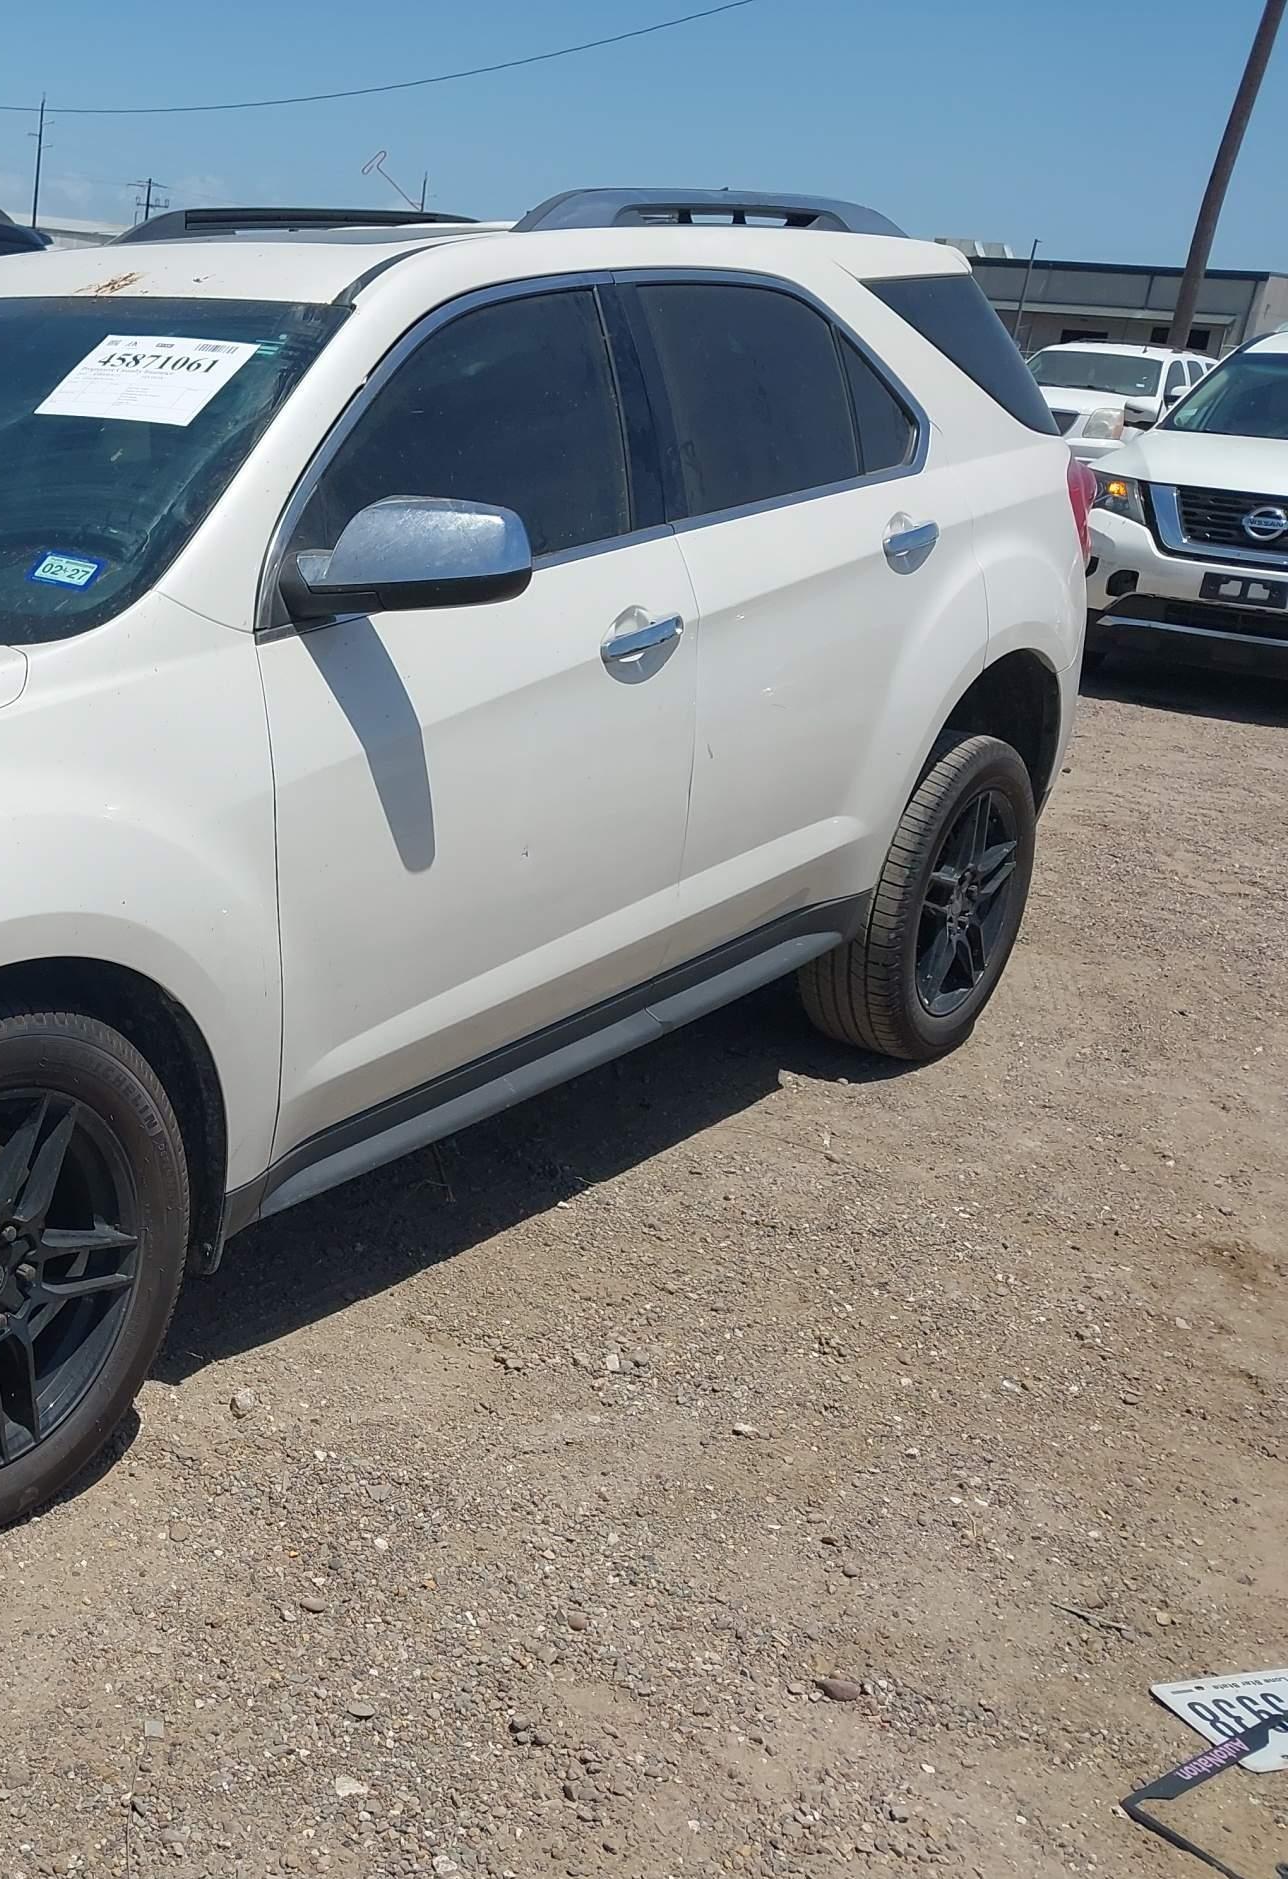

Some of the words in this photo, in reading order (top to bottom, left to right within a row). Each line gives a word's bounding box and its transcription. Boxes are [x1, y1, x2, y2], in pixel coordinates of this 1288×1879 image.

[97, 352, 219, 373] 45871061
[1248, 518, 1284, 528] NISSAN
[1175, 1738, 1250, 1780] AutoNation
